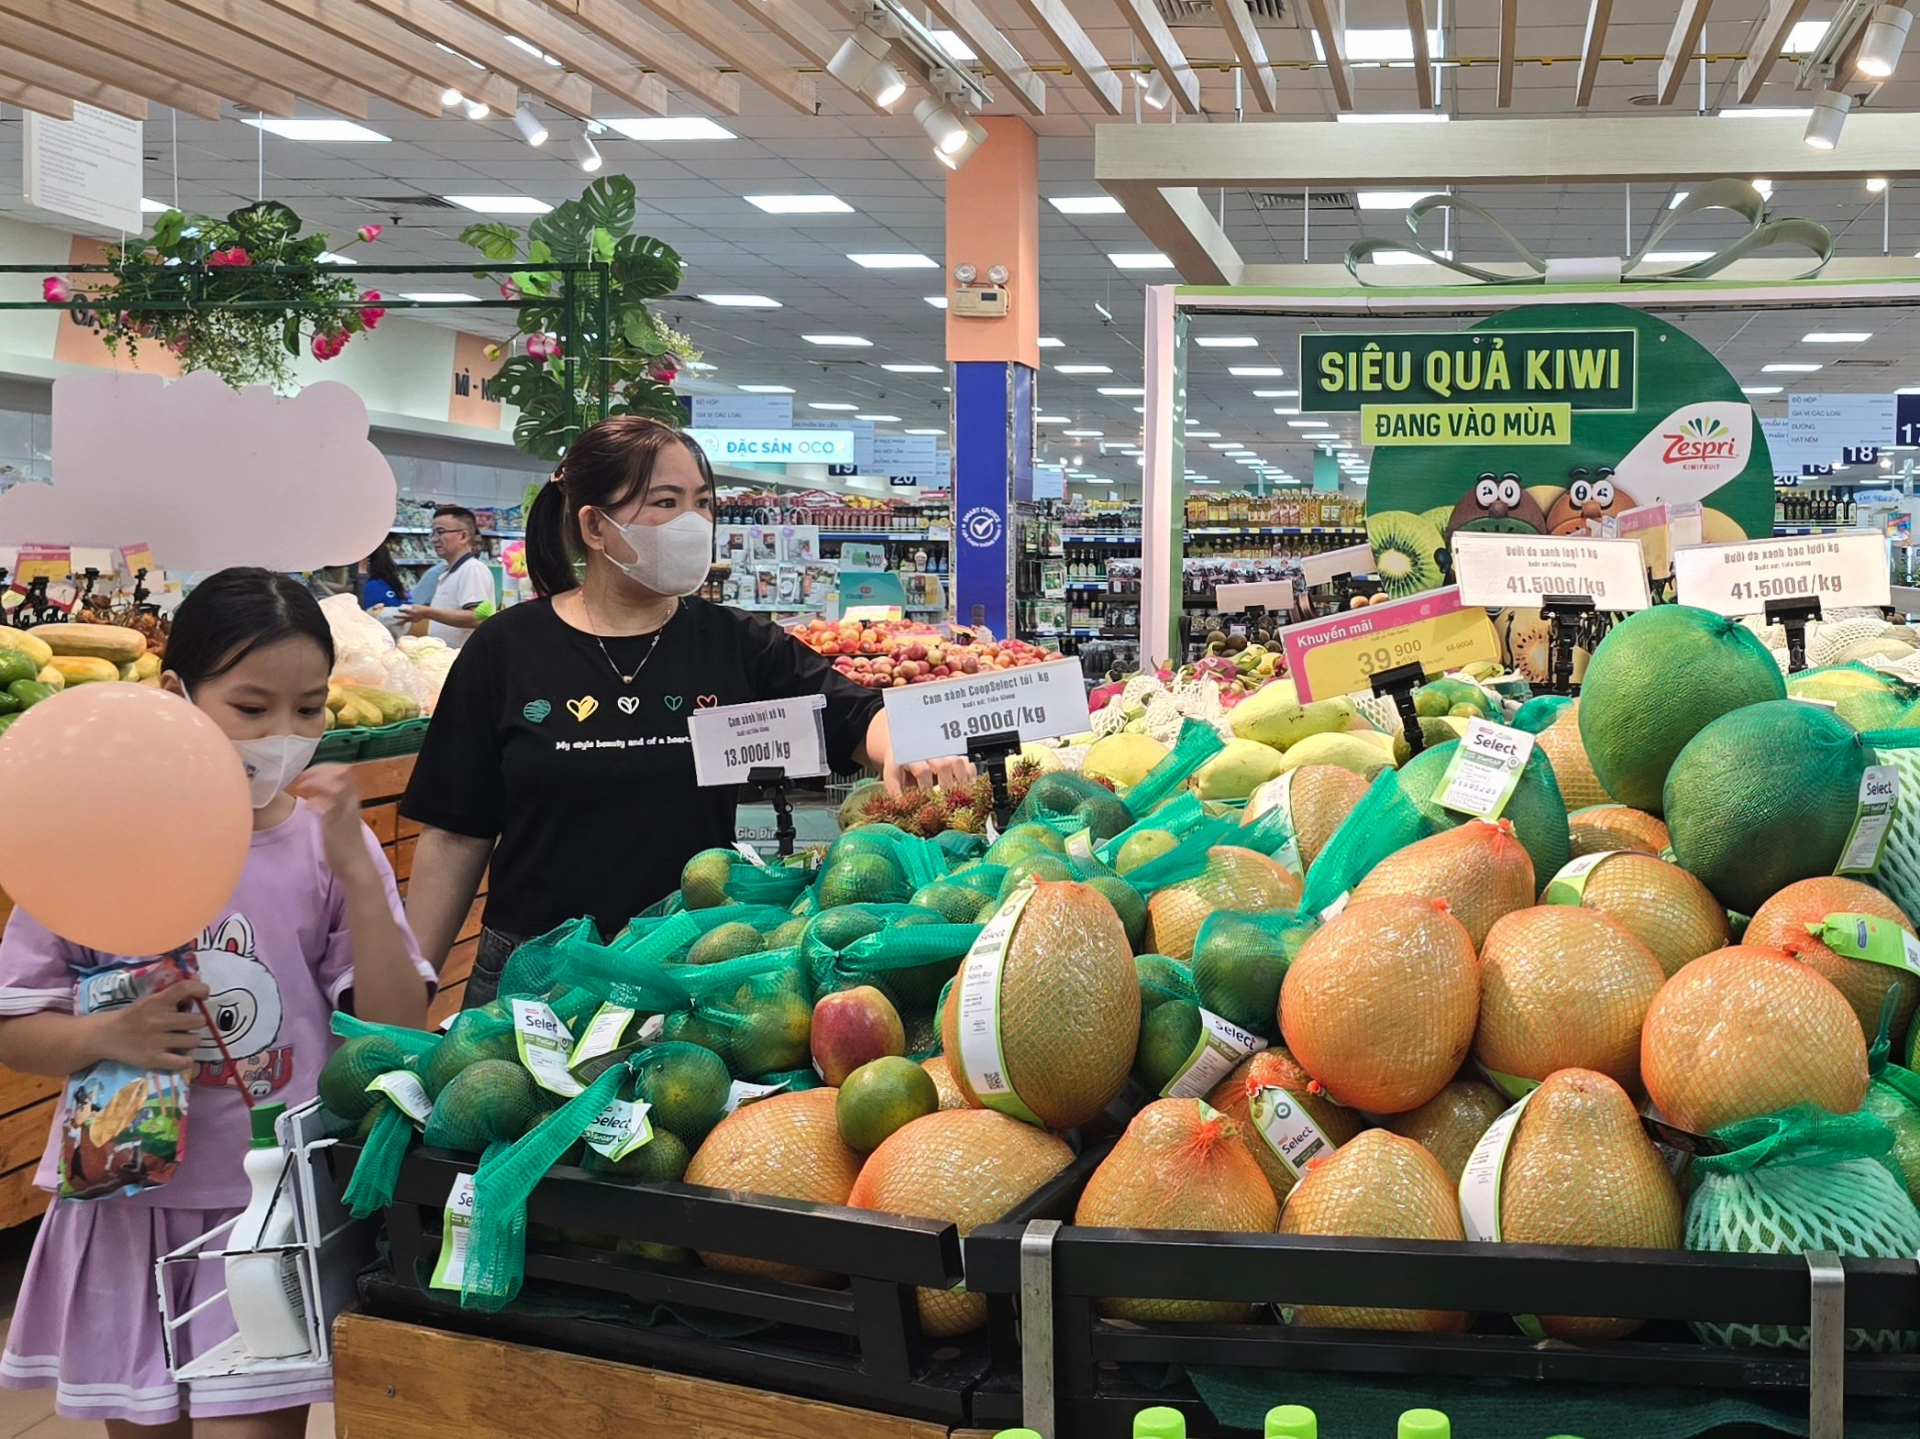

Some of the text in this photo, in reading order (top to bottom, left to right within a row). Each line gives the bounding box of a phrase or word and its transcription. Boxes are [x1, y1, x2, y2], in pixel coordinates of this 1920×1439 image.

[1319, 336, 1620, 398] SIÊU QUẢ KIWI
[1375, 406, 1556, 438] ĐANG VÀO MÙA
[727, 440, 758, 457] ĐẶC
[762, 438, 792, 454] SẢN
[1662, 434, 1736, 464] Zespri
[1850, 446, 1872, 462] 18
[1540, 548, 1560, 558] xanh
[1588, 548, 1598, 560] kg
[1762, 548, 1785, 560] xanh
[1787, 546, 1804, 557] bao
[1828, 542, 1840, 554] kg
[1506, 576, 1606, 597] 41.500đ/kg
[1730, 574, 1842, 600] 41.500đ/kg
[1297, 618, 1374, 648] Khuyến mãi
[922, 694, 942, 706] Cam
[944, 688, 966, 702] sành
[968, 677, 1018, 697] CoopSelect
[1038, 671, 1050, 682] kg
[728, 716, 741, 728] Cam
[742, 712, 756, 722] sành
[778, 708, 786, 718] kg
[940, 706, 1046, 740] 18.900đ/kg
[628, 737, 644, 746] and
[646, 736, 657, 746] of
[1473, 734, 1517, 756] Select
[724, 740, 791, 767] 13.000đ/kg
[1866, 780, 1893, 796] Select
[526, 1014, 558, 1034] Selec
[1215, 1020, 1256, 1050] Select
[1282, 1126, 1314, 1155] Select
